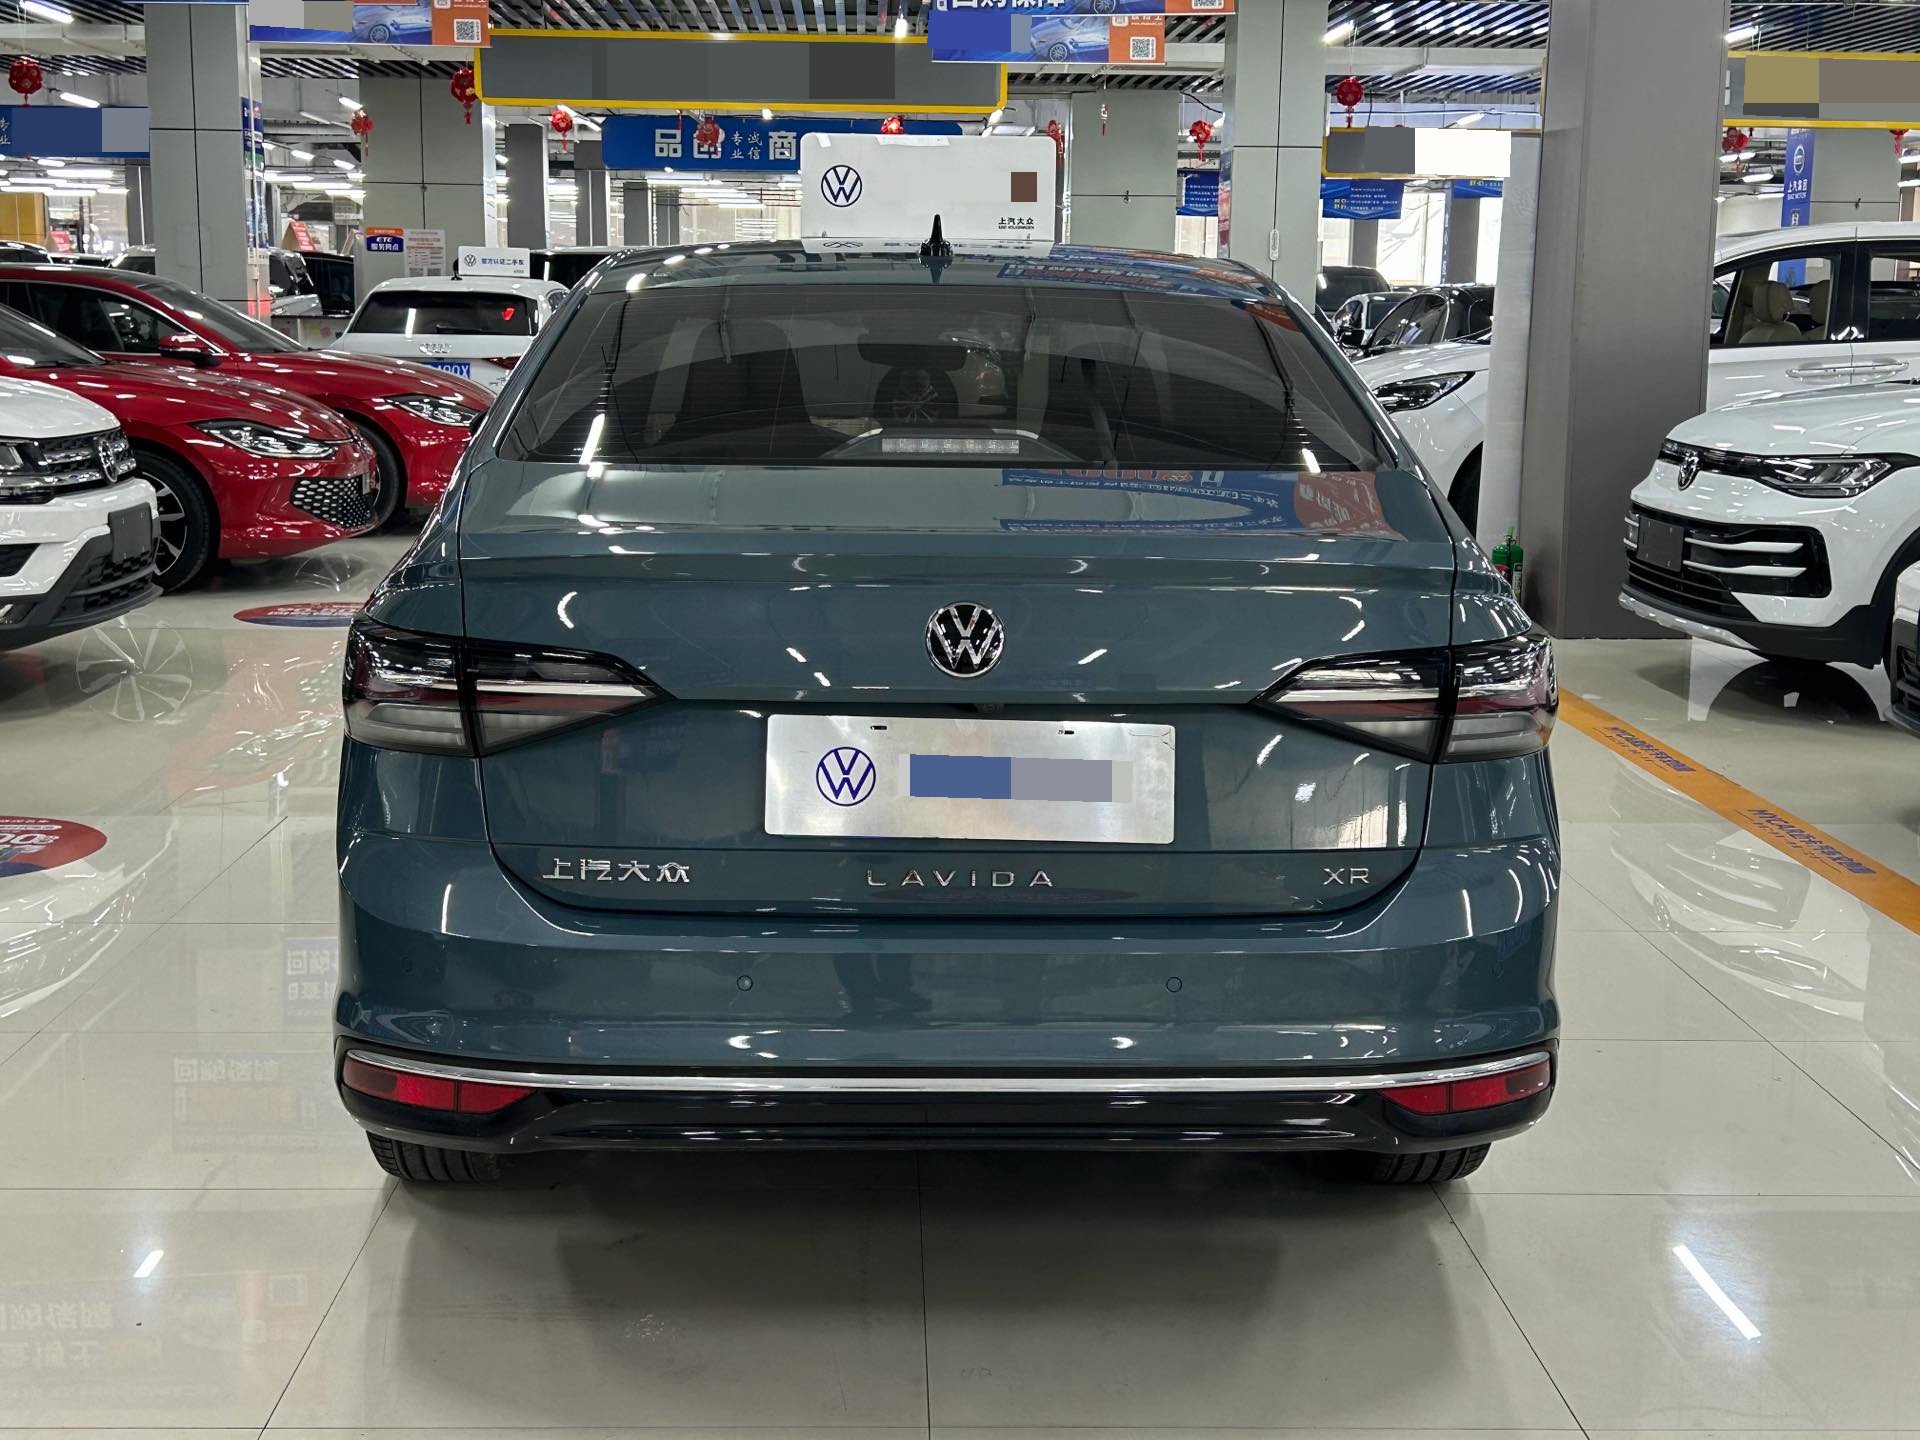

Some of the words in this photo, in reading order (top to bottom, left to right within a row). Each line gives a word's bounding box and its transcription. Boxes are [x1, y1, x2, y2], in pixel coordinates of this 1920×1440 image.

[998, 216, 1035, 225] 上汽大众
[542, 857, 690, 883] 上汽大众
[867, 868, 1053, 888] LAVIDA
[1323, 867, 1370, 886] XR
